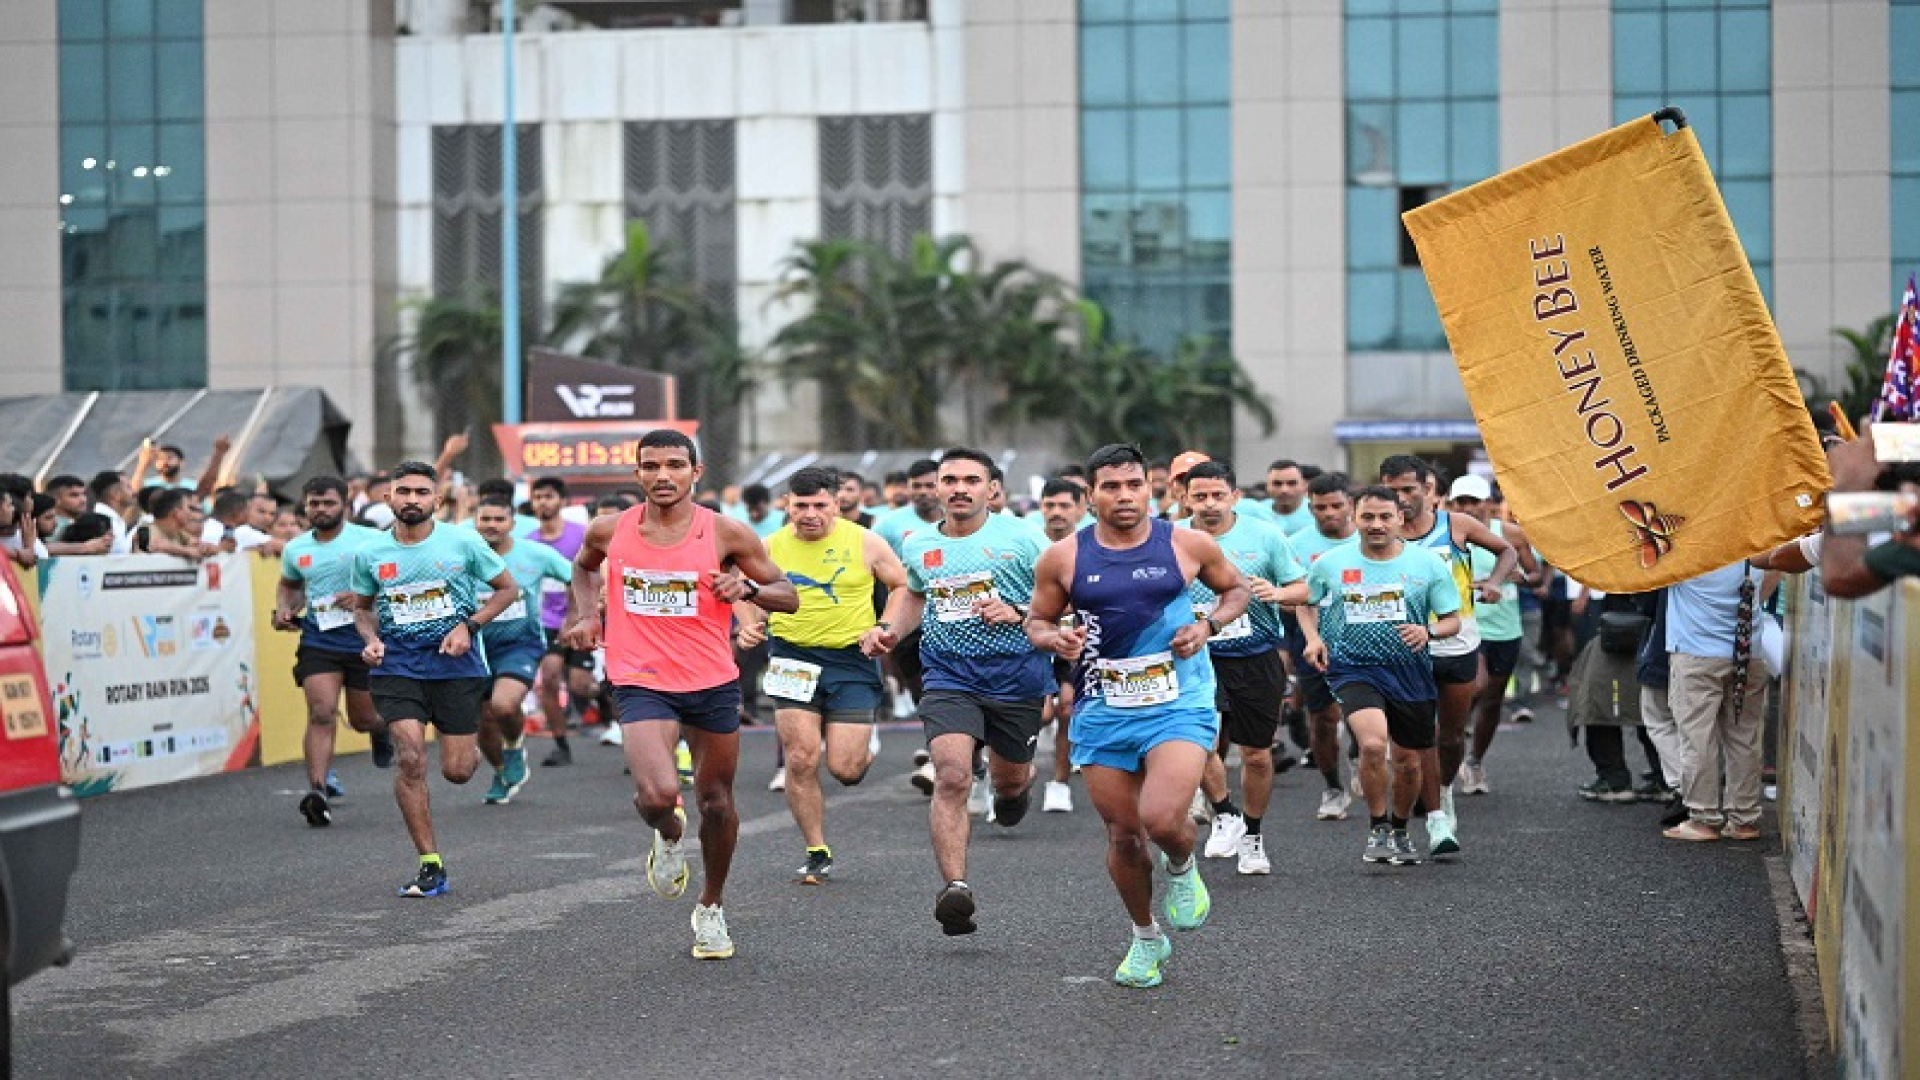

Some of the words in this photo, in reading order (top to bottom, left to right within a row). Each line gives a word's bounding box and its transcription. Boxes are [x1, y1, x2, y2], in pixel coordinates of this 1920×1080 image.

[1530, 233, 1578, 320] BEE
[1588, 245, 1614, 294] WATER
[1606, 296, 1641, 368] DRINKING
[1548, 329, 1648, 490] HONEY
[1632, 368, 1671, 444] PACKAGED
[641, 587, 678, 604] 10126
[72, 629, 102, 649] Rotary
[106, 684, 144, 705] ROTARY
[146, 681, 169, 700] RAIN
[170, 678, 188, 696] RUN
